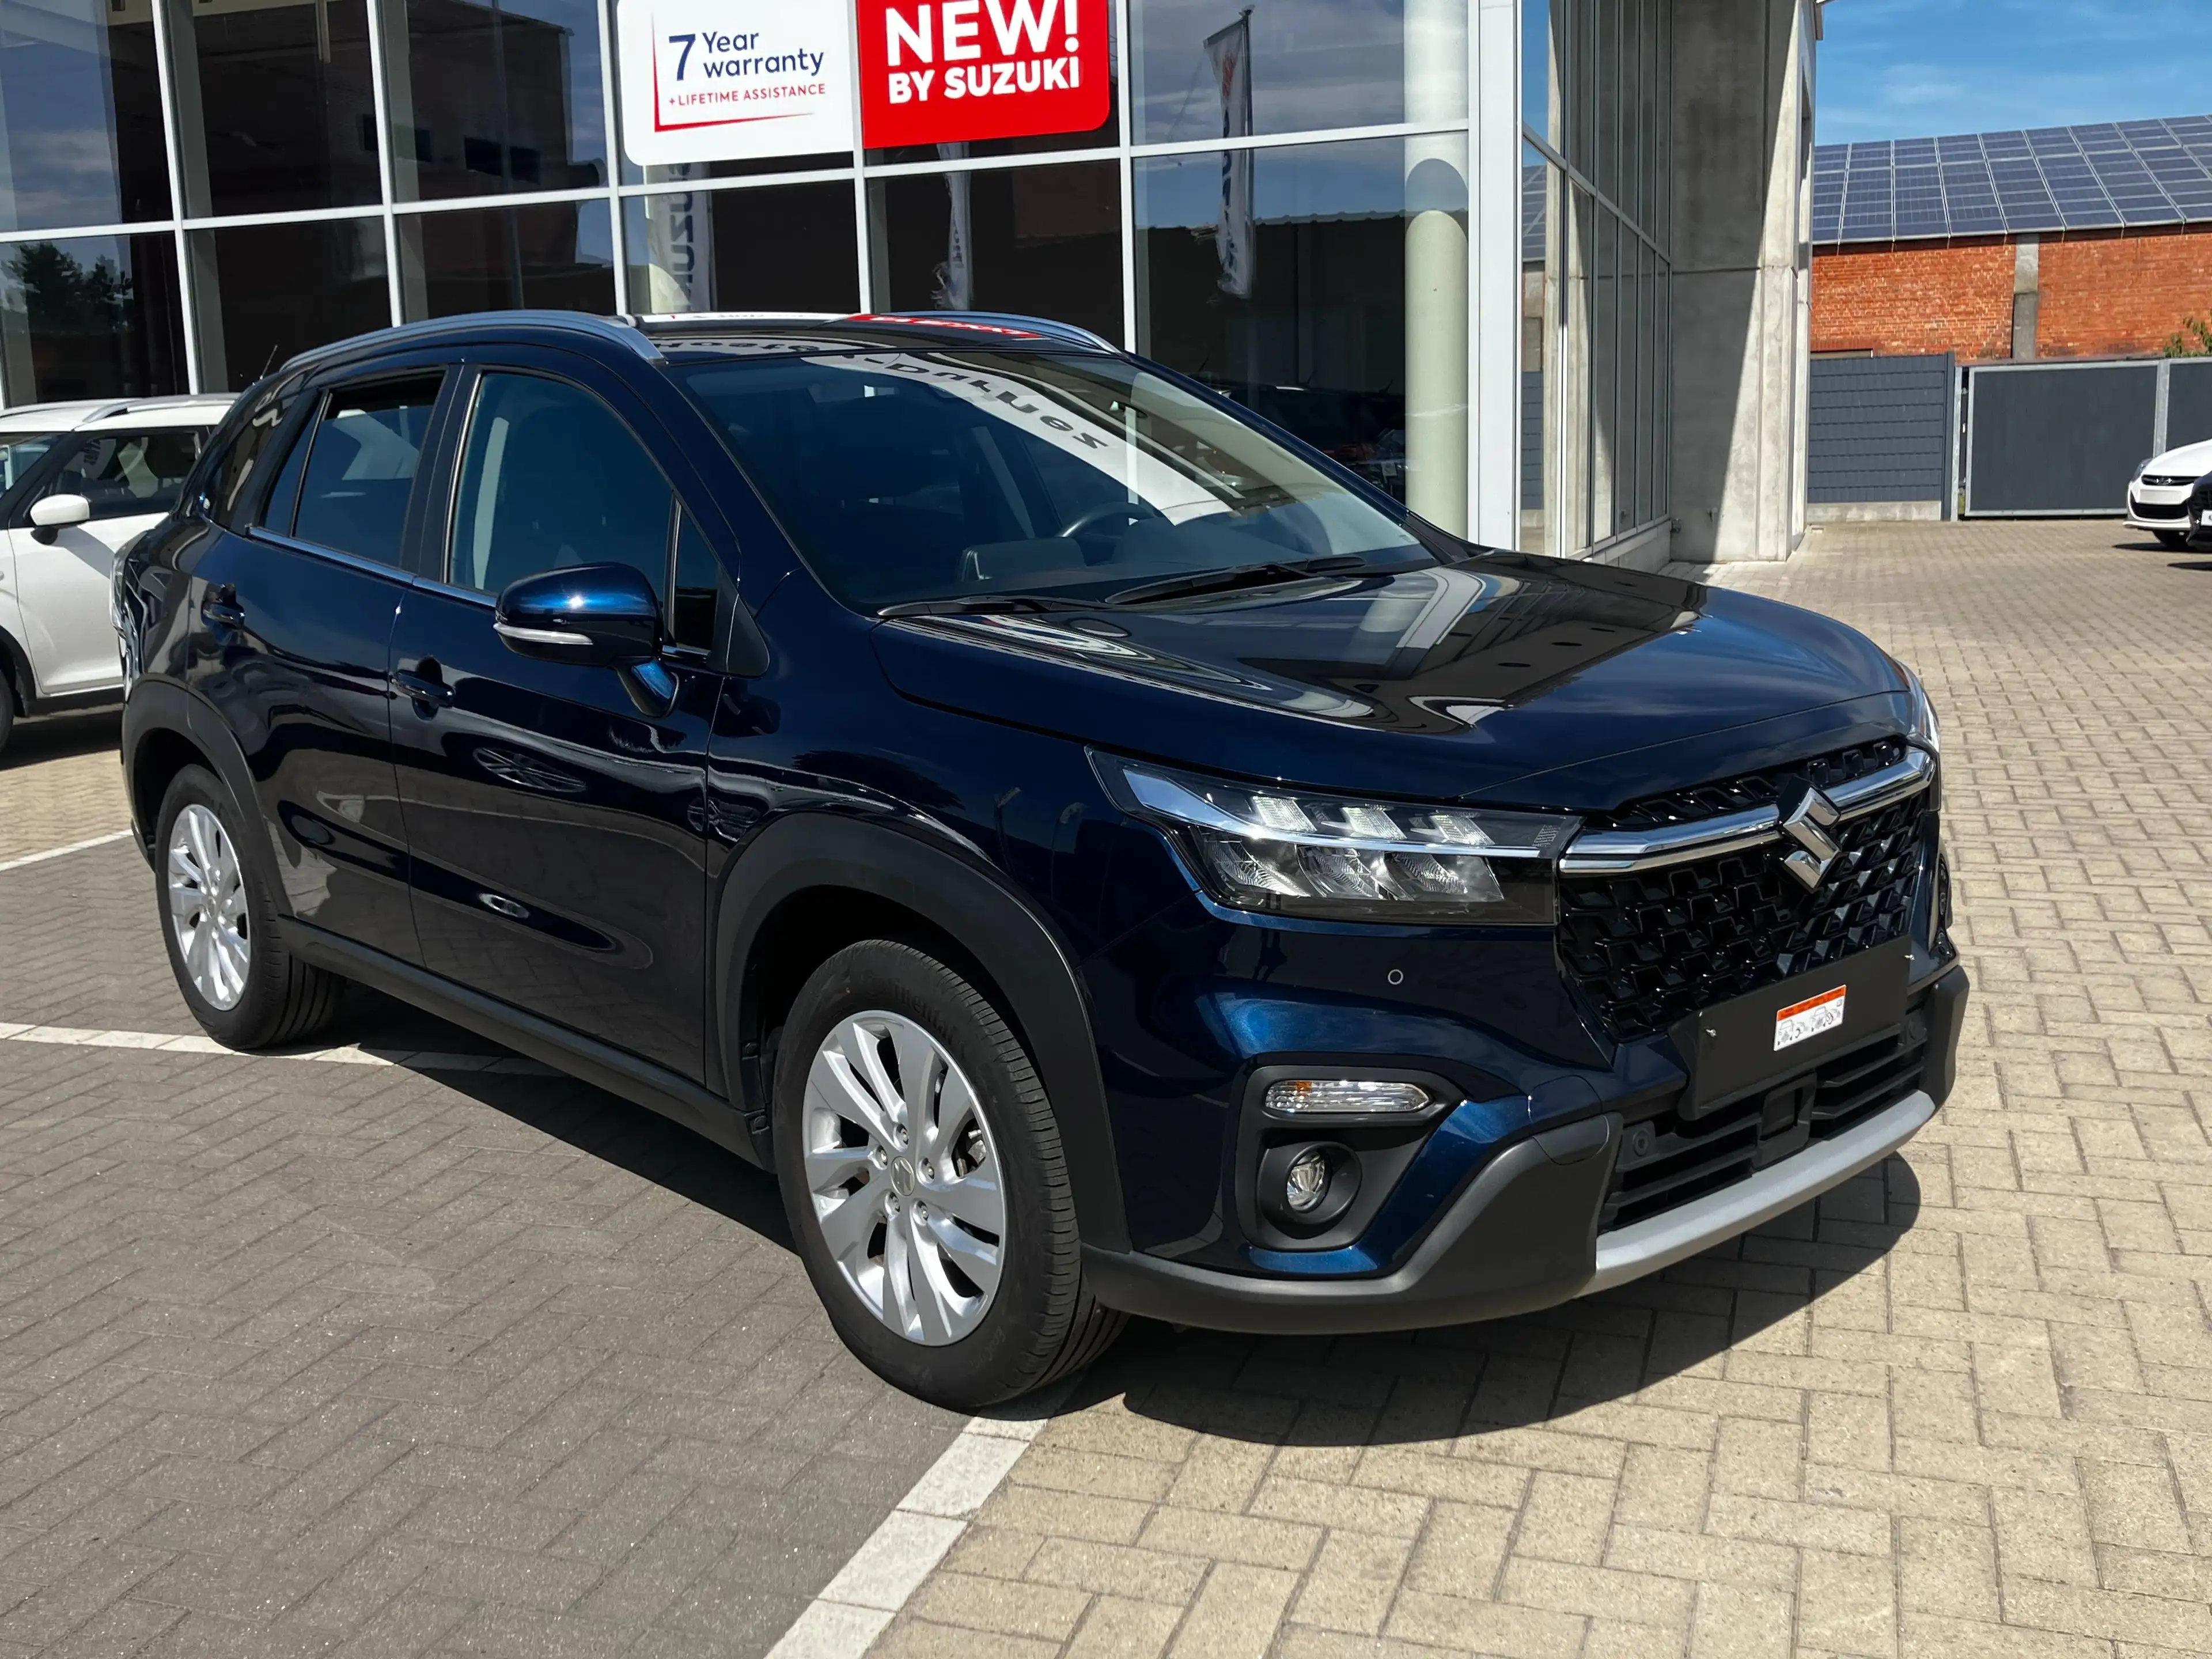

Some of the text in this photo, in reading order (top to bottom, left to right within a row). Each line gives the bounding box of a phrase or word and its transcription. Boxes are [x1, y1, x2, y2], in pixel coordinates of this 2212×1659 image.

[668, 31, 759, 81] 7 Year
[885, 0, 1079, 67] NEW!
[703, 48, 824, 78] warranty
[888, 56, 1080, 104] BY SUZUKI
[678, 90, 739, 106] LIFETIME
[743, 83, 825, 101] ASSISTANCE
